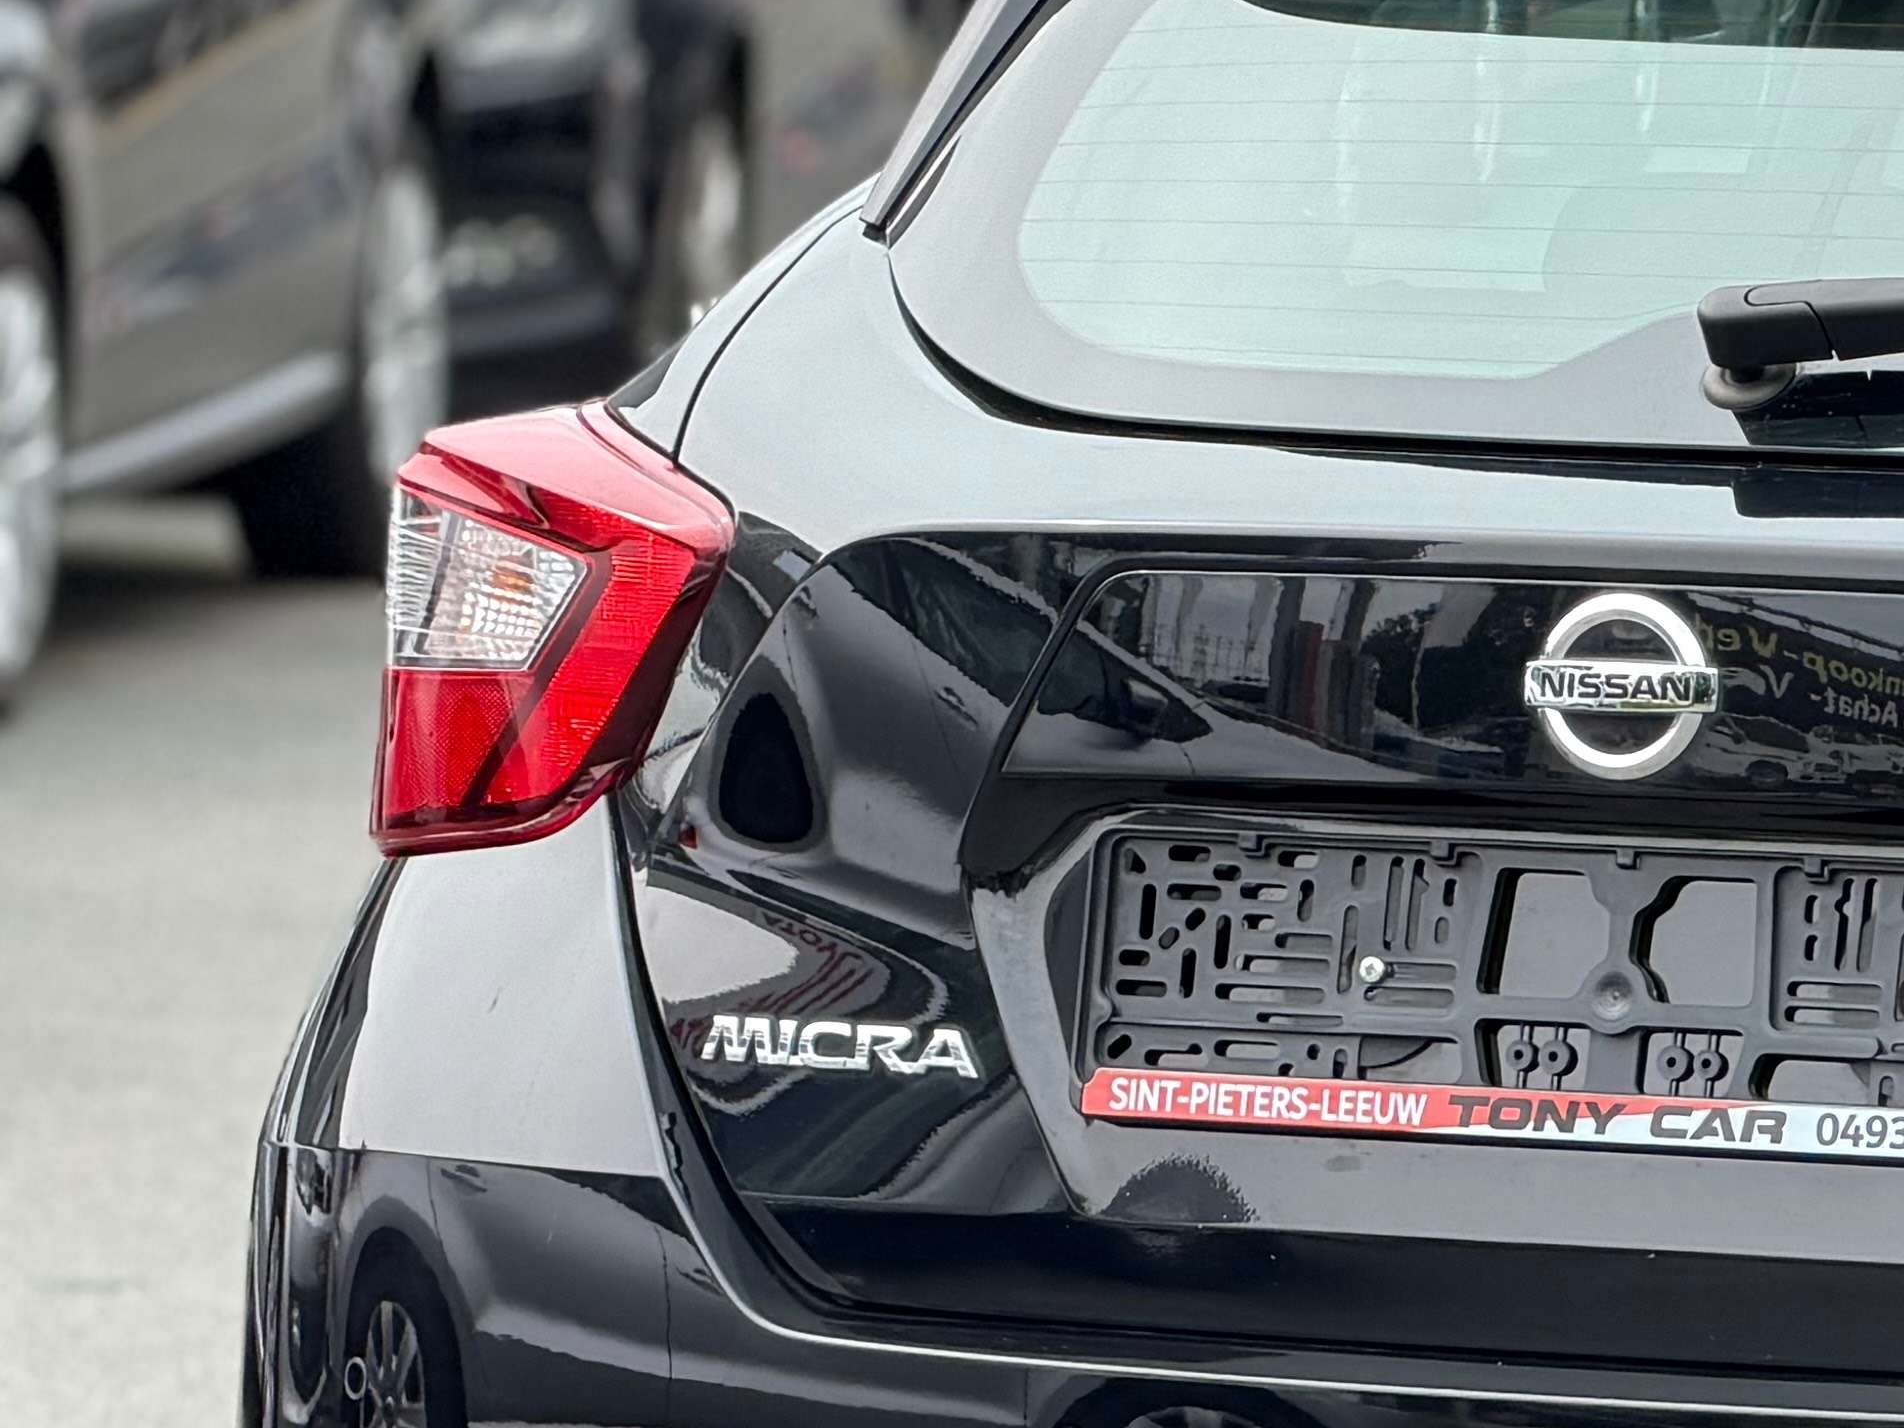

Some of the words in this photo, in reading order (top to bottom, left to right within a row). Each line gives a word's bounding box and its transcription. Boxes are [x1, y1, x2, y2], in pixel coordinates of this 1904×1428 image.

[1539, 670, 1692, 701] NISSAN
[700, 1014, 979, 1079] MICRA
[1109, 1076, 1428, 1127] SINT-PIETERS-LEEUW
[1448, 1094, 1627, 1135] TONY
[1649, 1105, 1788, 1145] CAR
